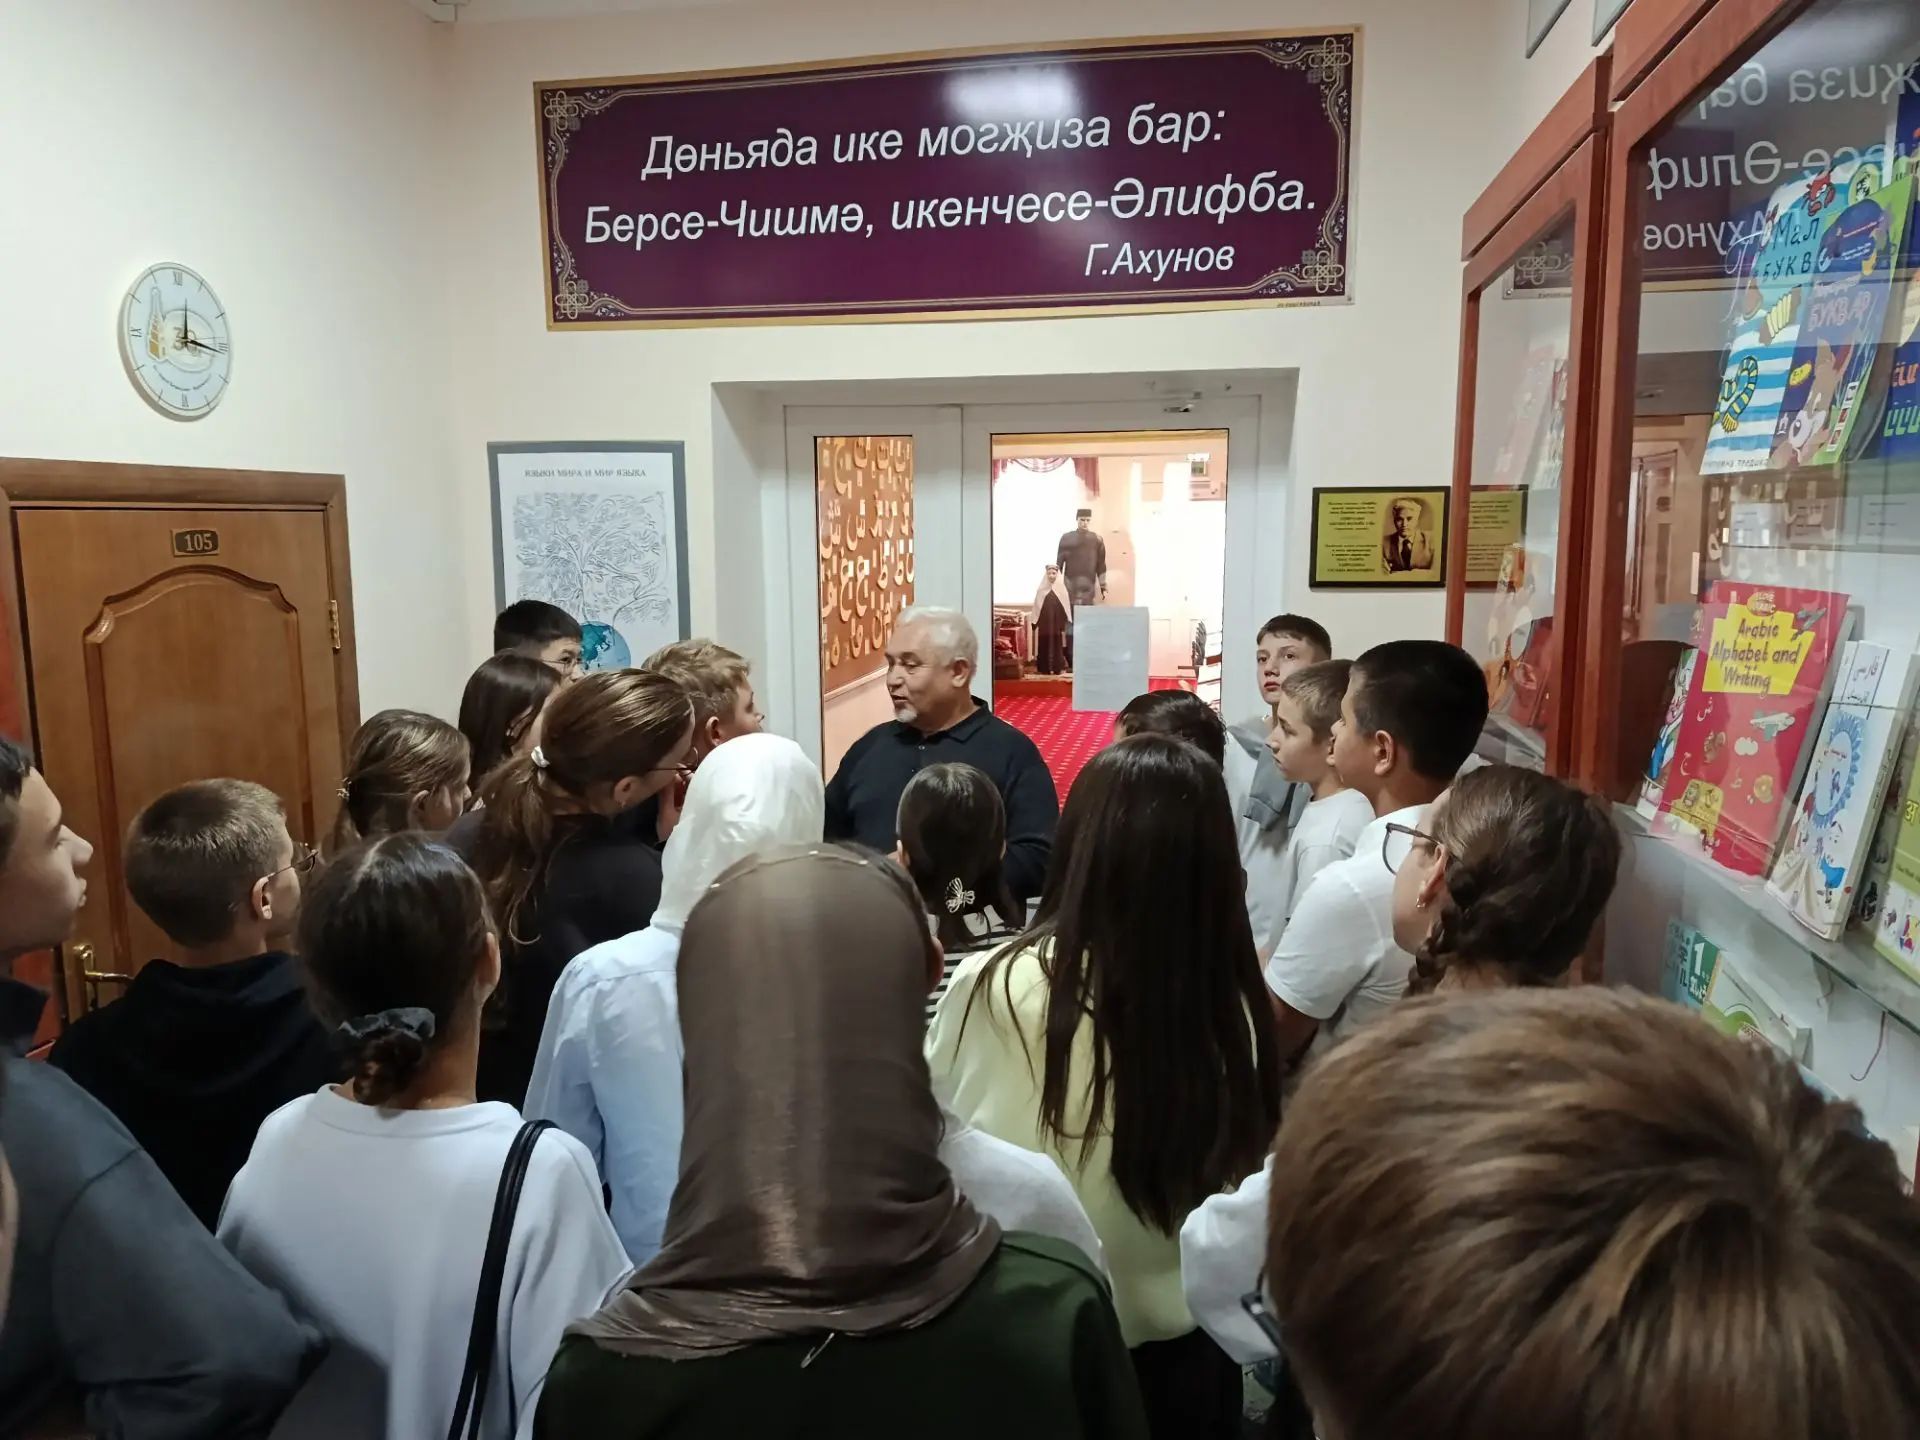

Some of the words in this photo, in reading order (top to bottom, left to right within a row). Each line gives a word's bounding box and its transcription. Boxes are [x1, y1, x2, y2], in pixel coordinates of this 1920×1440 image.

[640, 127, 818, 181] Дөньяда
[832, 129, 904, 164] ике
[917, 116, 1111, 159] могҗиза
[1127, 102, 1225, 153] бар:
[584, 199, 874, 252] Берсе-Чишмә,
[891, 170, 1316, 231] икенчесе-Әлифба.
[1084, 242, 1236, 282] Г.Ахунов
[524, 469, 555, 478] ЯЗЫКИ
[557, 469, 583, 478] МИРА
[594, 469, 614, 477] МИР
[616, 468, 647, 477] ЯЗЫКА
[184, 533, 213, 552] 105
[1738, 615, 1780, 640] Arabic
[1711, 640, 1769, 667] Alphabet
[1772, 641, 1802, 665] and
[1723, 664, 1772, 699] Writing
